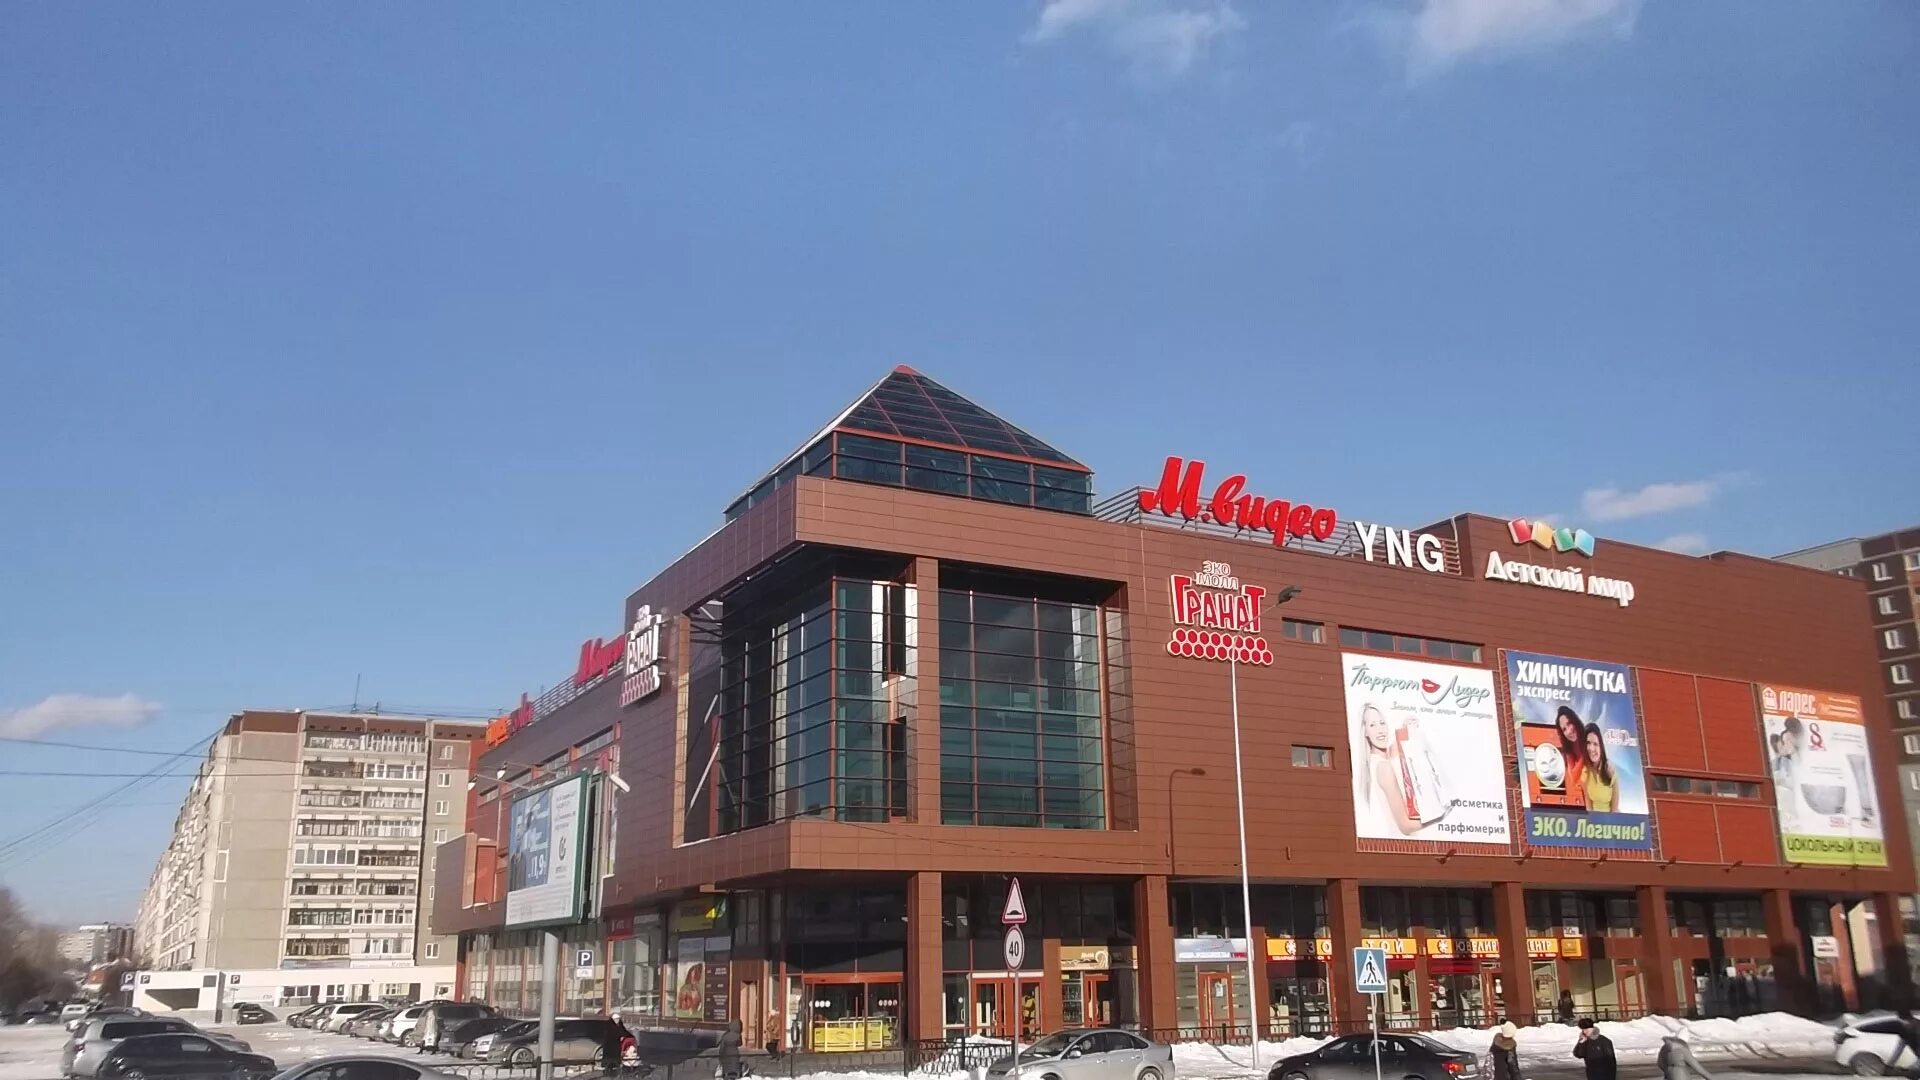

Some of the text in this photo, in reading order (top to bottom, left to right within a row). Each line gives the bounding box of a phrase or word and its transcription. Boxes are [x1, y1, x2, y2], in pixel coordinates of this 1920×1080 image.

[1138, 456, 1336, 547] М.видео
[1353, 520, 1445, 573] YNG
[1202, 560, 1231, 575] ЭКО
[1195, 572, 1239, 590] МОЛЛ
[1485, 550, 1634, 607] Детский мир
[1170, 574, 1266, 633] ГРАНАТ
[1515, 659, 1627, 694] ХИМЧИСТКА
[1517, 686, 1571, 702] экспресс
[1450, 799, 1503, 810] косметика
[1498, 814, 1504, 822] и
[1437, 822, 1505, 836] парфюмерия
[1532, 816, 1645, 841] ЭКО. Логично!
[1009, 941, 1020, 957] 40
[580, 952, 591, 966] P
